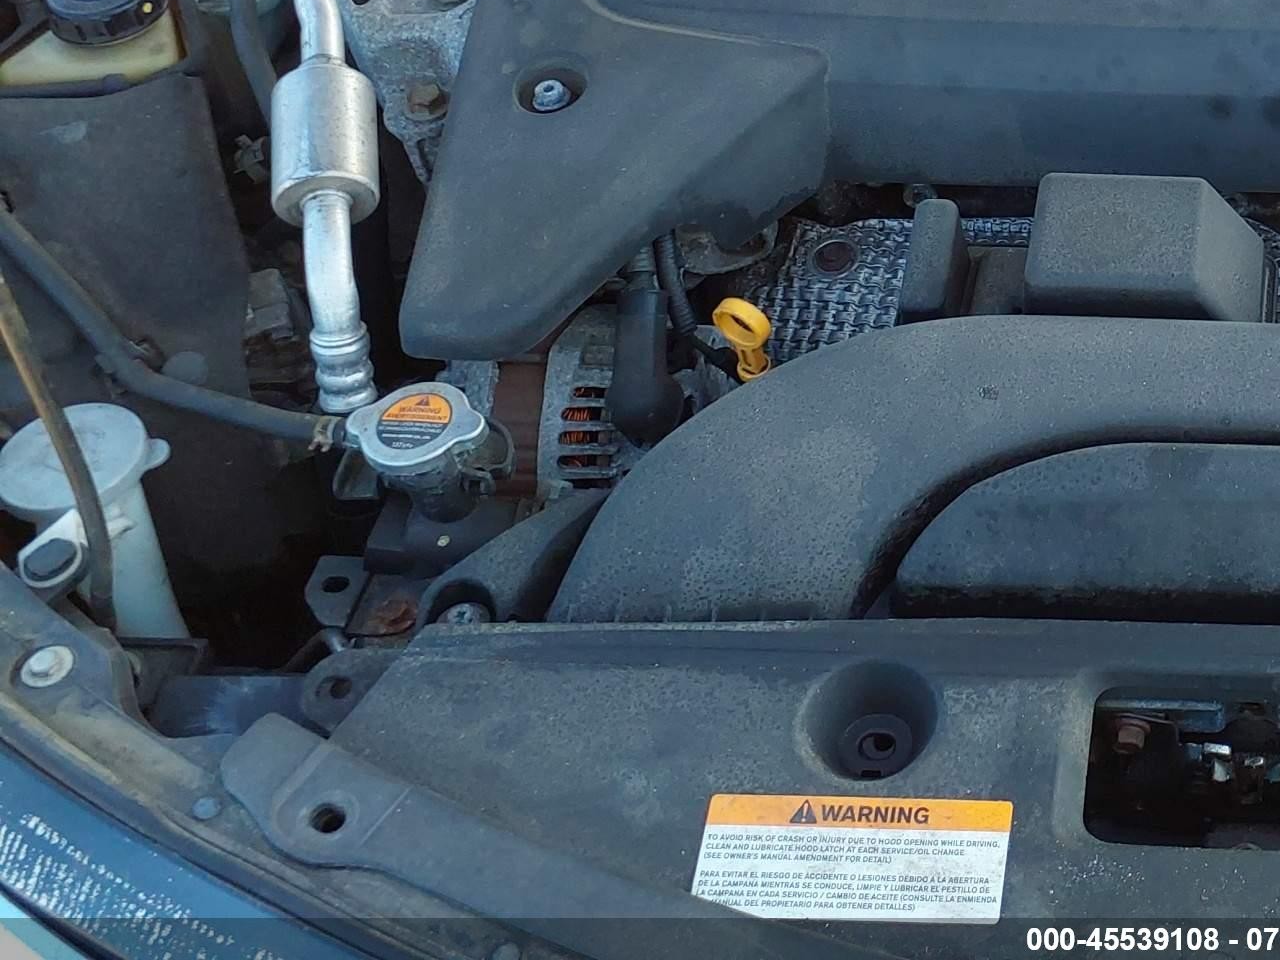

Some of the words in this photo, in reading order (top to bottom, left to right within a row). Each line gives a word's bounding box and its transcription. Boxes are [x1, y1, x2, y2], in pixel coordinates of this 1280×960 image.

[822, 804, 930, 824] WARNING
[819, 836, 846, 844] INJURY
[956, 895, 997, 903] ENMIENDA
[761, 900, 812, 908] PROPIETARIO
[836, 901, 872, 910] OBTENER
[874, 903, 915, 911] DETALLES)
